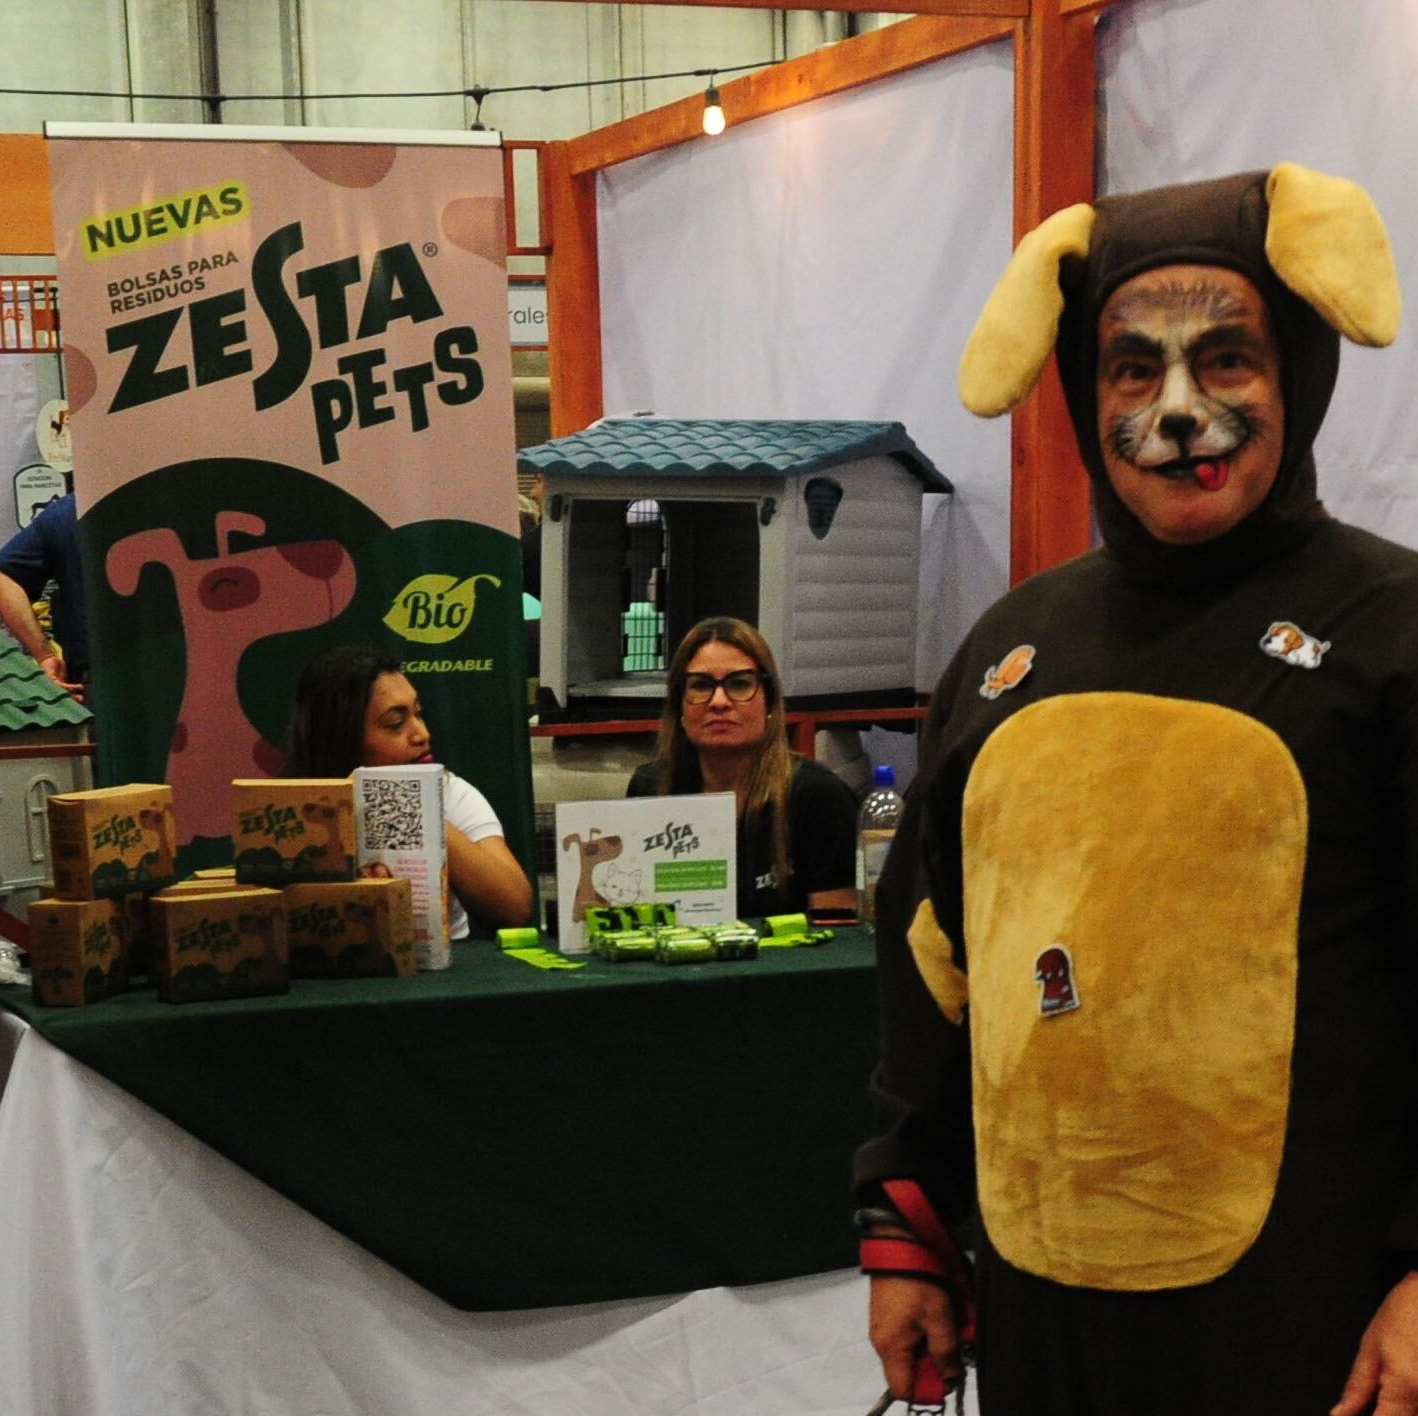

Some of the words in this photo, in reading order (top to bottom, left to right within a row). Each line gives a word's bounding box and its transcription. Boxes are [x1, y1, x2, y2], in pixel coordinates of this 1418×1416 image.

[86, 187, 242, 253] NUEVAS
[107, 265, 182, 297] BOLSAS
[188, 251, 238, 274] PARA
[110, 276, 205, 314] RESIDUOS
[106, 221, 444, 414] ZESTA
[311, 326, 484, 464] PETS
[402, 591, 467, 630] Bio
[400, 659, 493, 673] EGRADABLE
[643, 822, 693, 852] ZESTA
